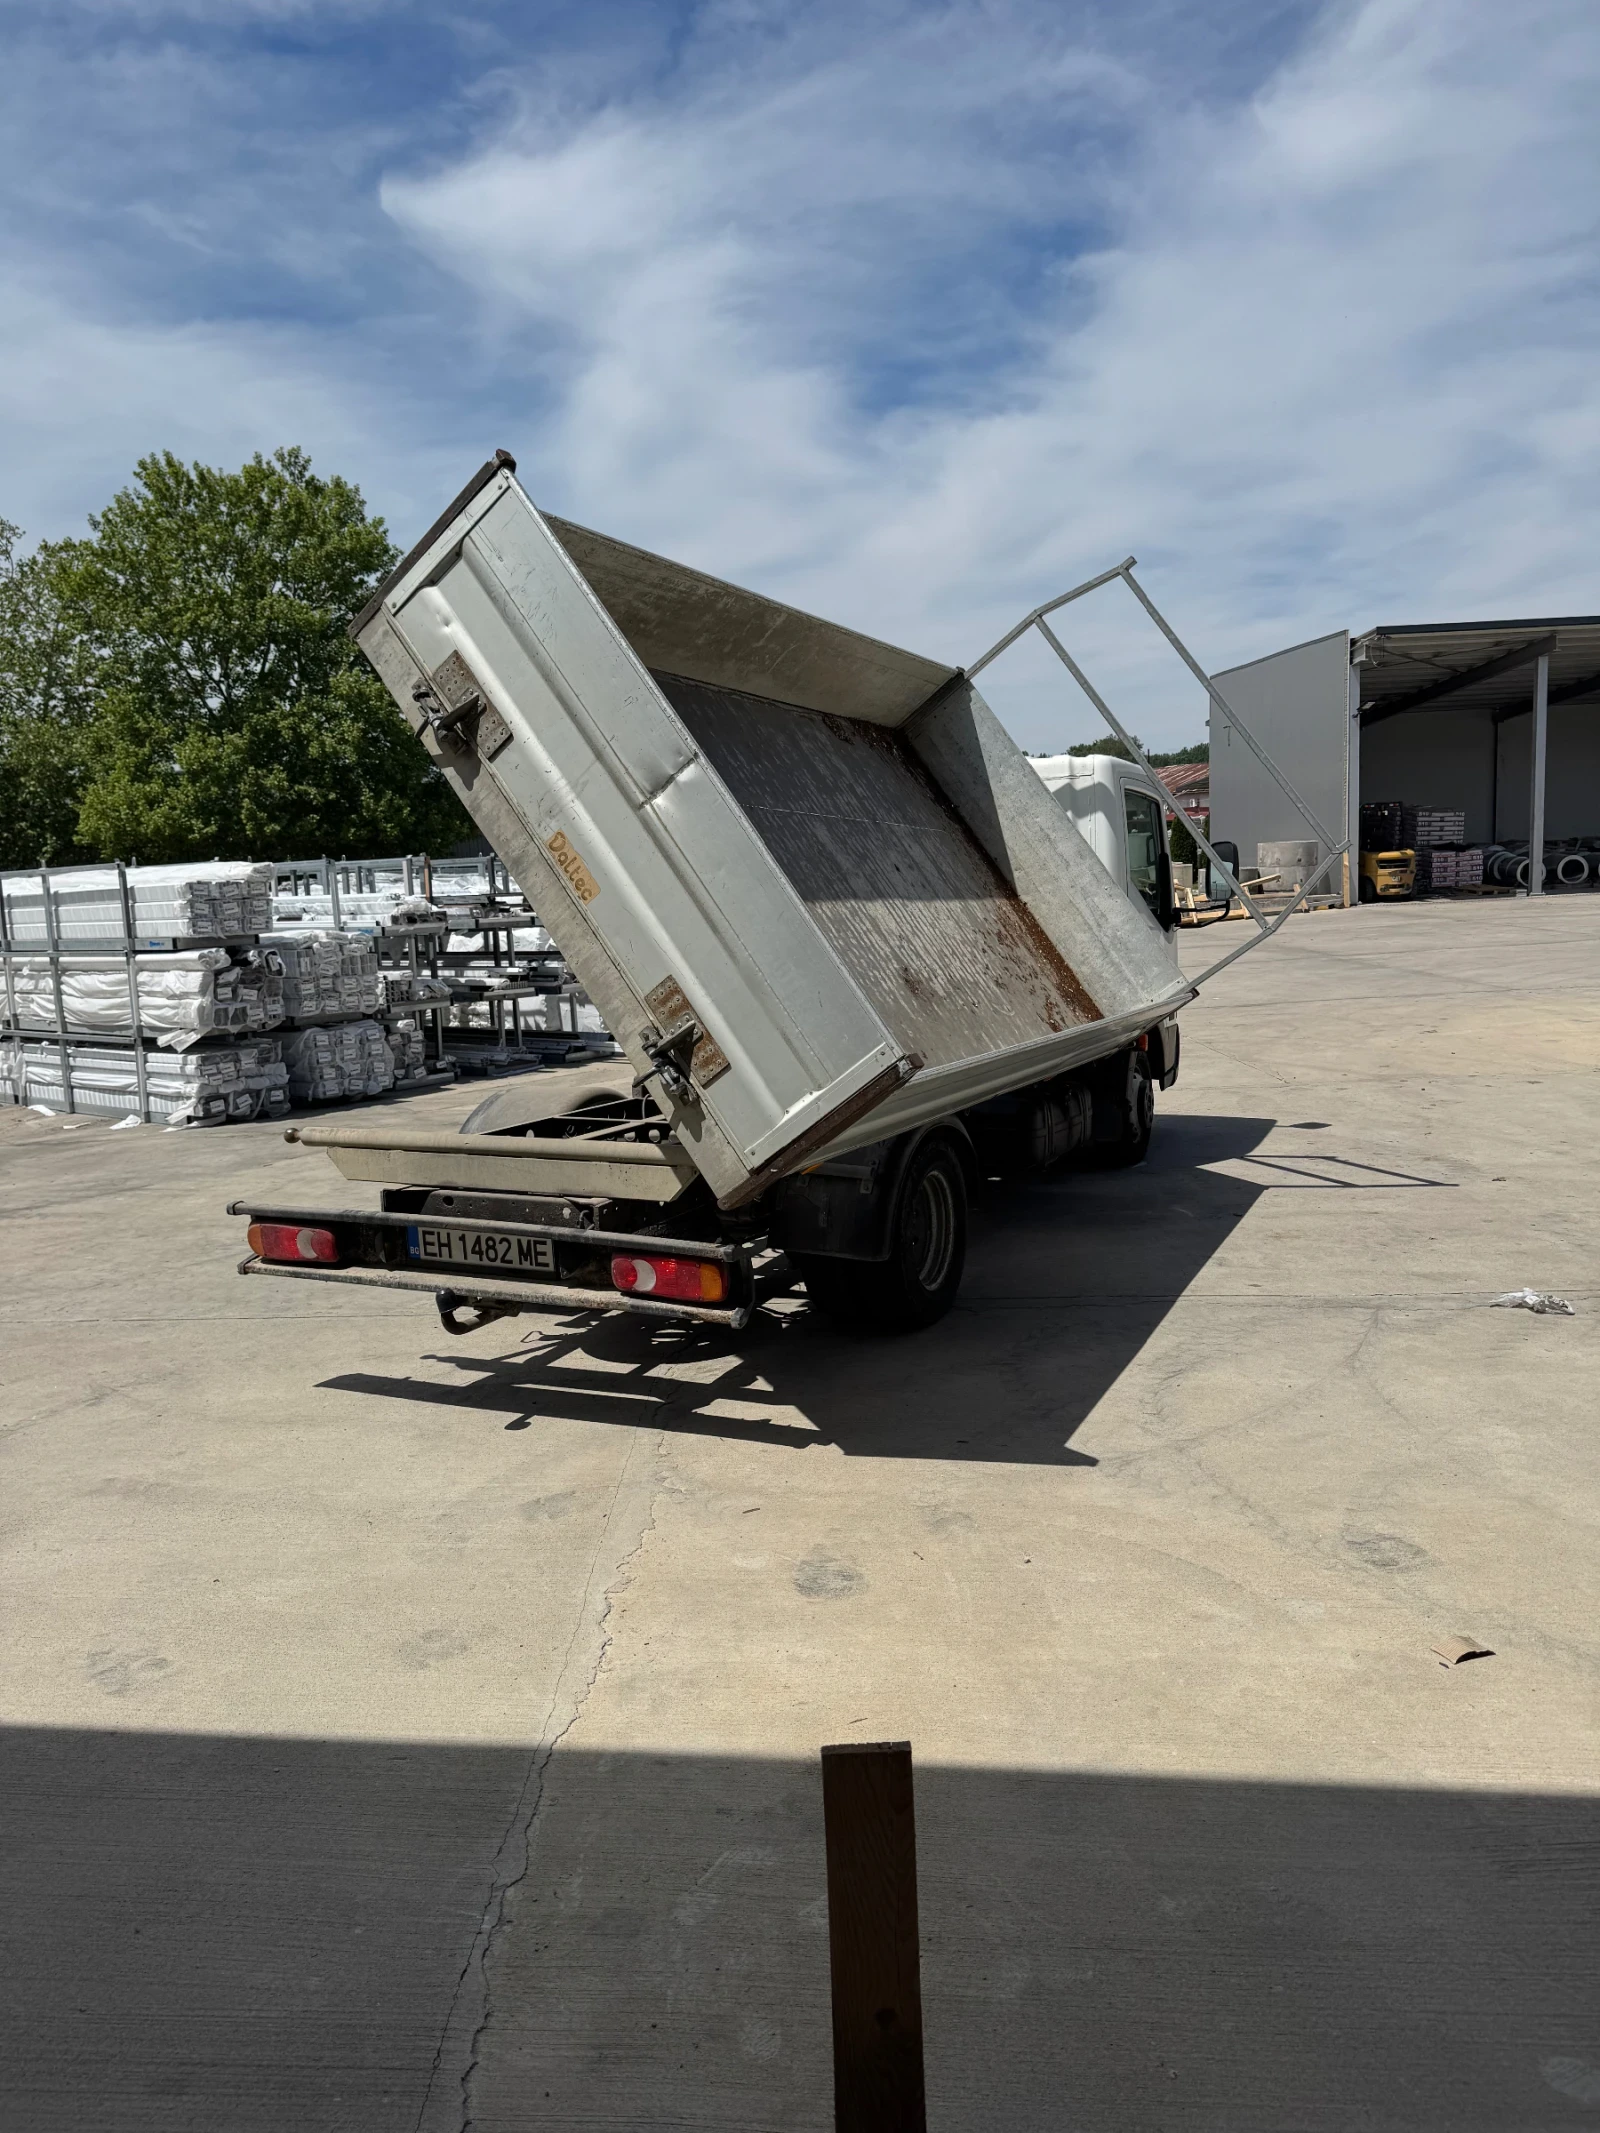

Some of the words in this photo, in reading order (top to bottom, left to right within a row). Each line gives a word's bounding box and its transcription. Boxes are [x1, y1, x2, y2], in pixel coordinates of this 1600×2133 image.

[548, 831, 593, 901] Daltec
[411, 1247, 419, 1255] BG
[422, 1230, 452, 1258] EH
[458, 1233, 513, 1264] 1482
[517, 1238, 550, 1267] ME
